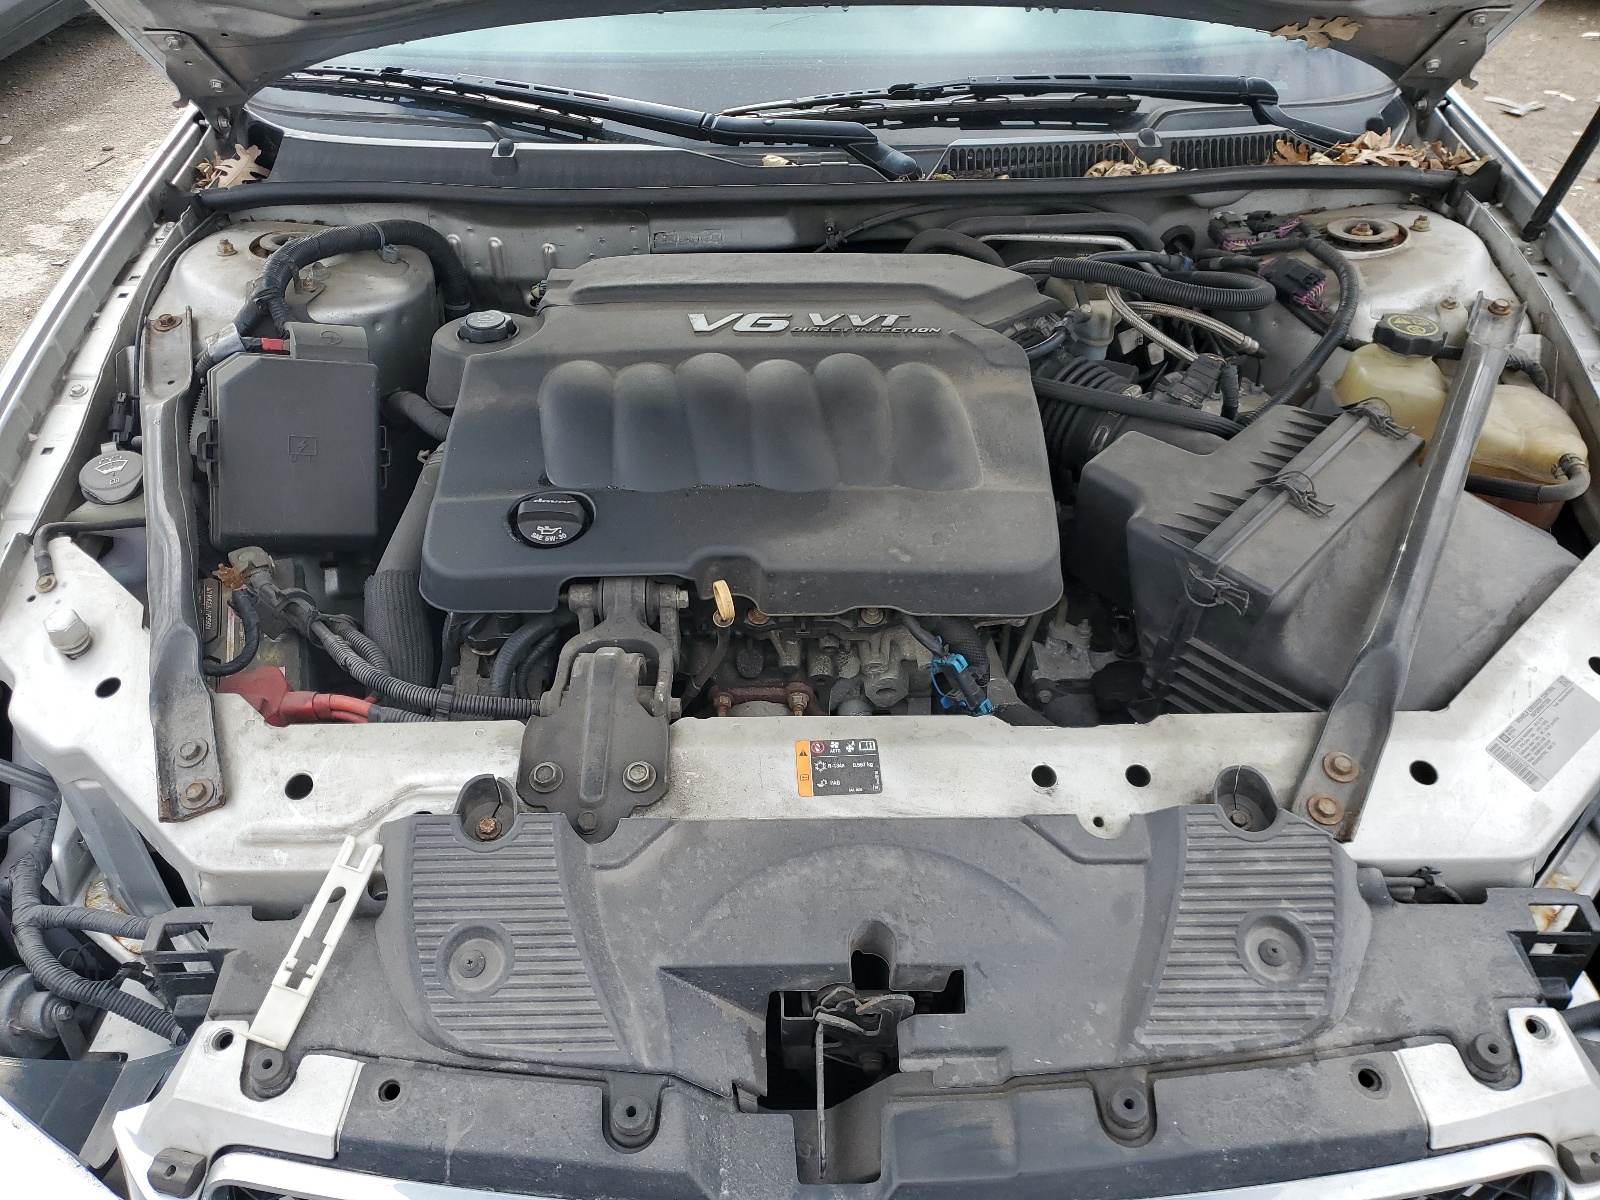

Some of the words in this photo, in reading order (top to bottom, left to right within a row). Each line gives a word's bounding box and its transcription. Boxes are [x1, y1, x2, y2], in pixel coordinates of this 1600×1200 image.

[687, 313, 792, 333] V6
[808, 313, 911, 328] VVT
[791, 326, 852, 334] DIRECT
[854, 326, 942, 334] INJECTION
[531, 532, 544, 541] SAE
[545, 533, 567, 541] 5W-30
